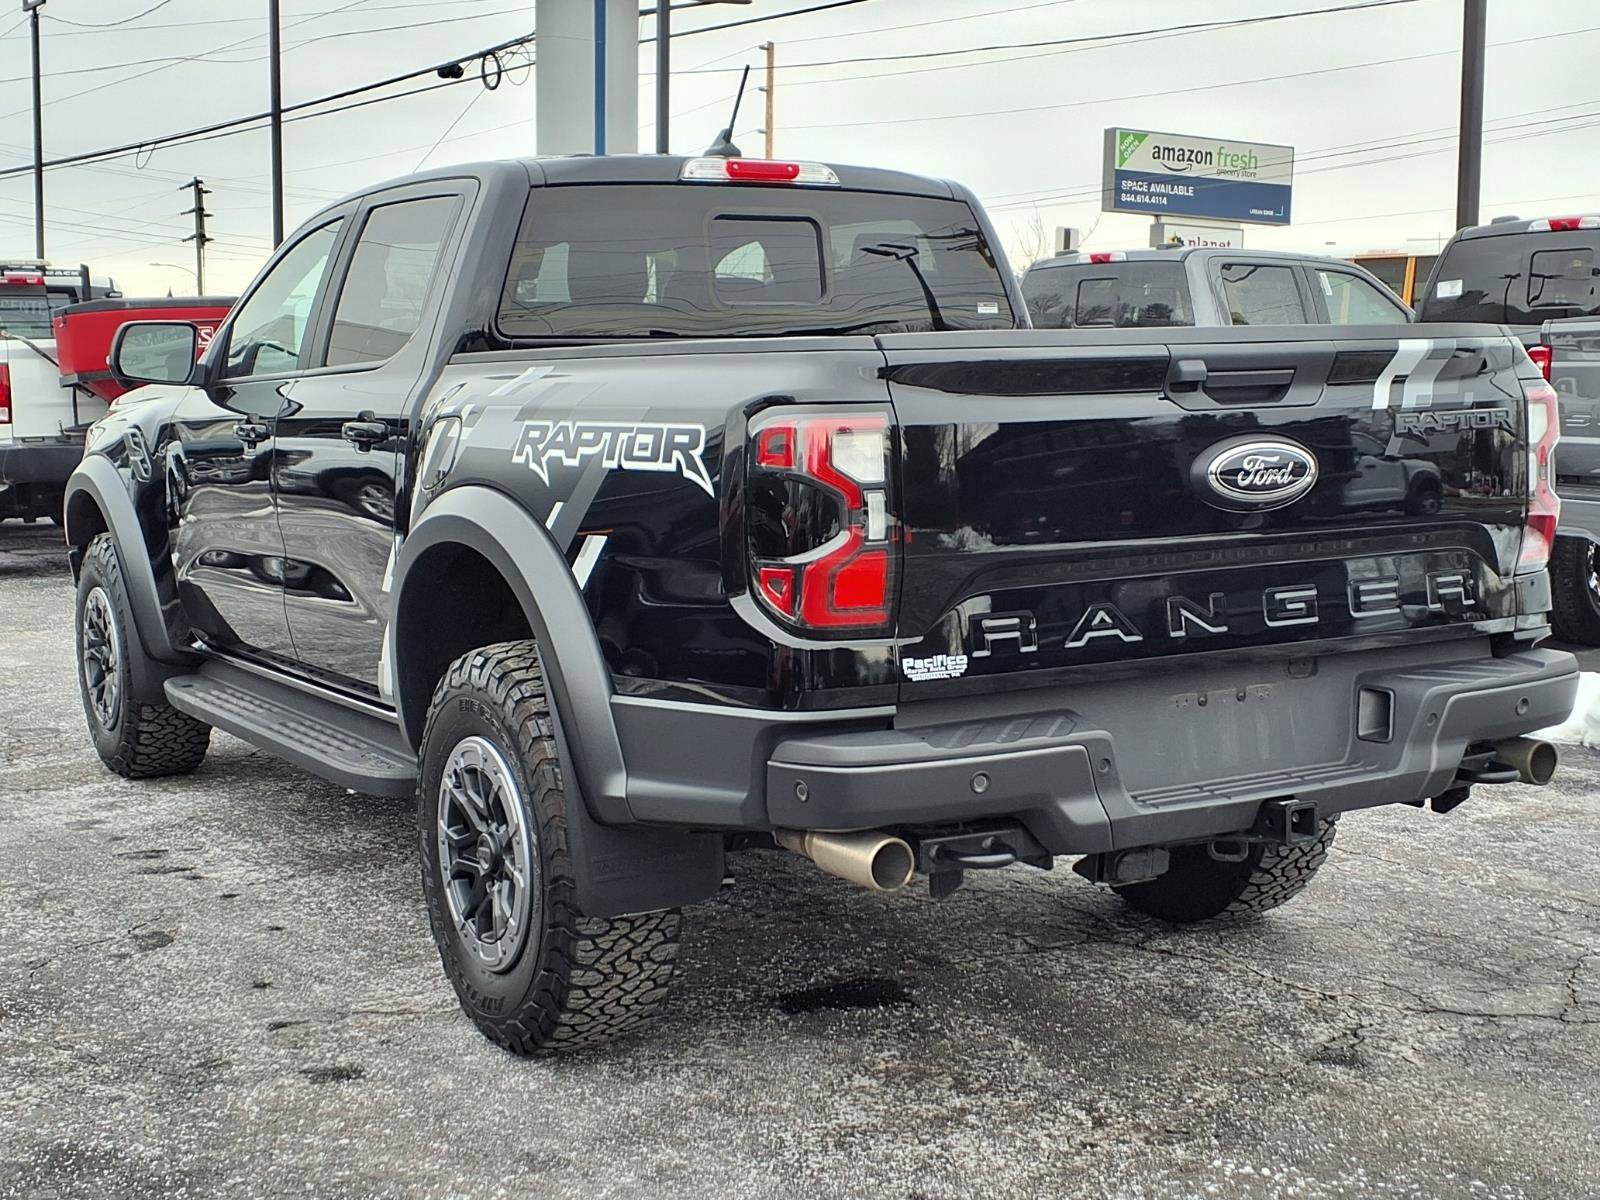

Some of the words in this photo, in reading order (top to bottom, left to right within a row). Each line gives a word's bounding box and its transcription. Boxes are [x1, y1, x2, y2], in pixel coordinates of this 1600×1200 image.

[1119, 133, 1134, 152] NOW
[1123, 139, 1140, 159] OPEN
[1152, 144, 1213, 166] amazon
[1217, 146, 1258, 170] fresh
[1241, 170, 1257, 178] store
[1121, 180, 1148, 192] SPACE
[1150, 183, 1194, 196] AVAILABLE
[1395, 408, 1516, 447] RAPTOR
[512, 420, 716, 499] RAPTOR
[1236, 455, 1294, 487] Ford
[969, 568, 1476, 657] RANGER
[902, 654, 968, 669] Pacifico
